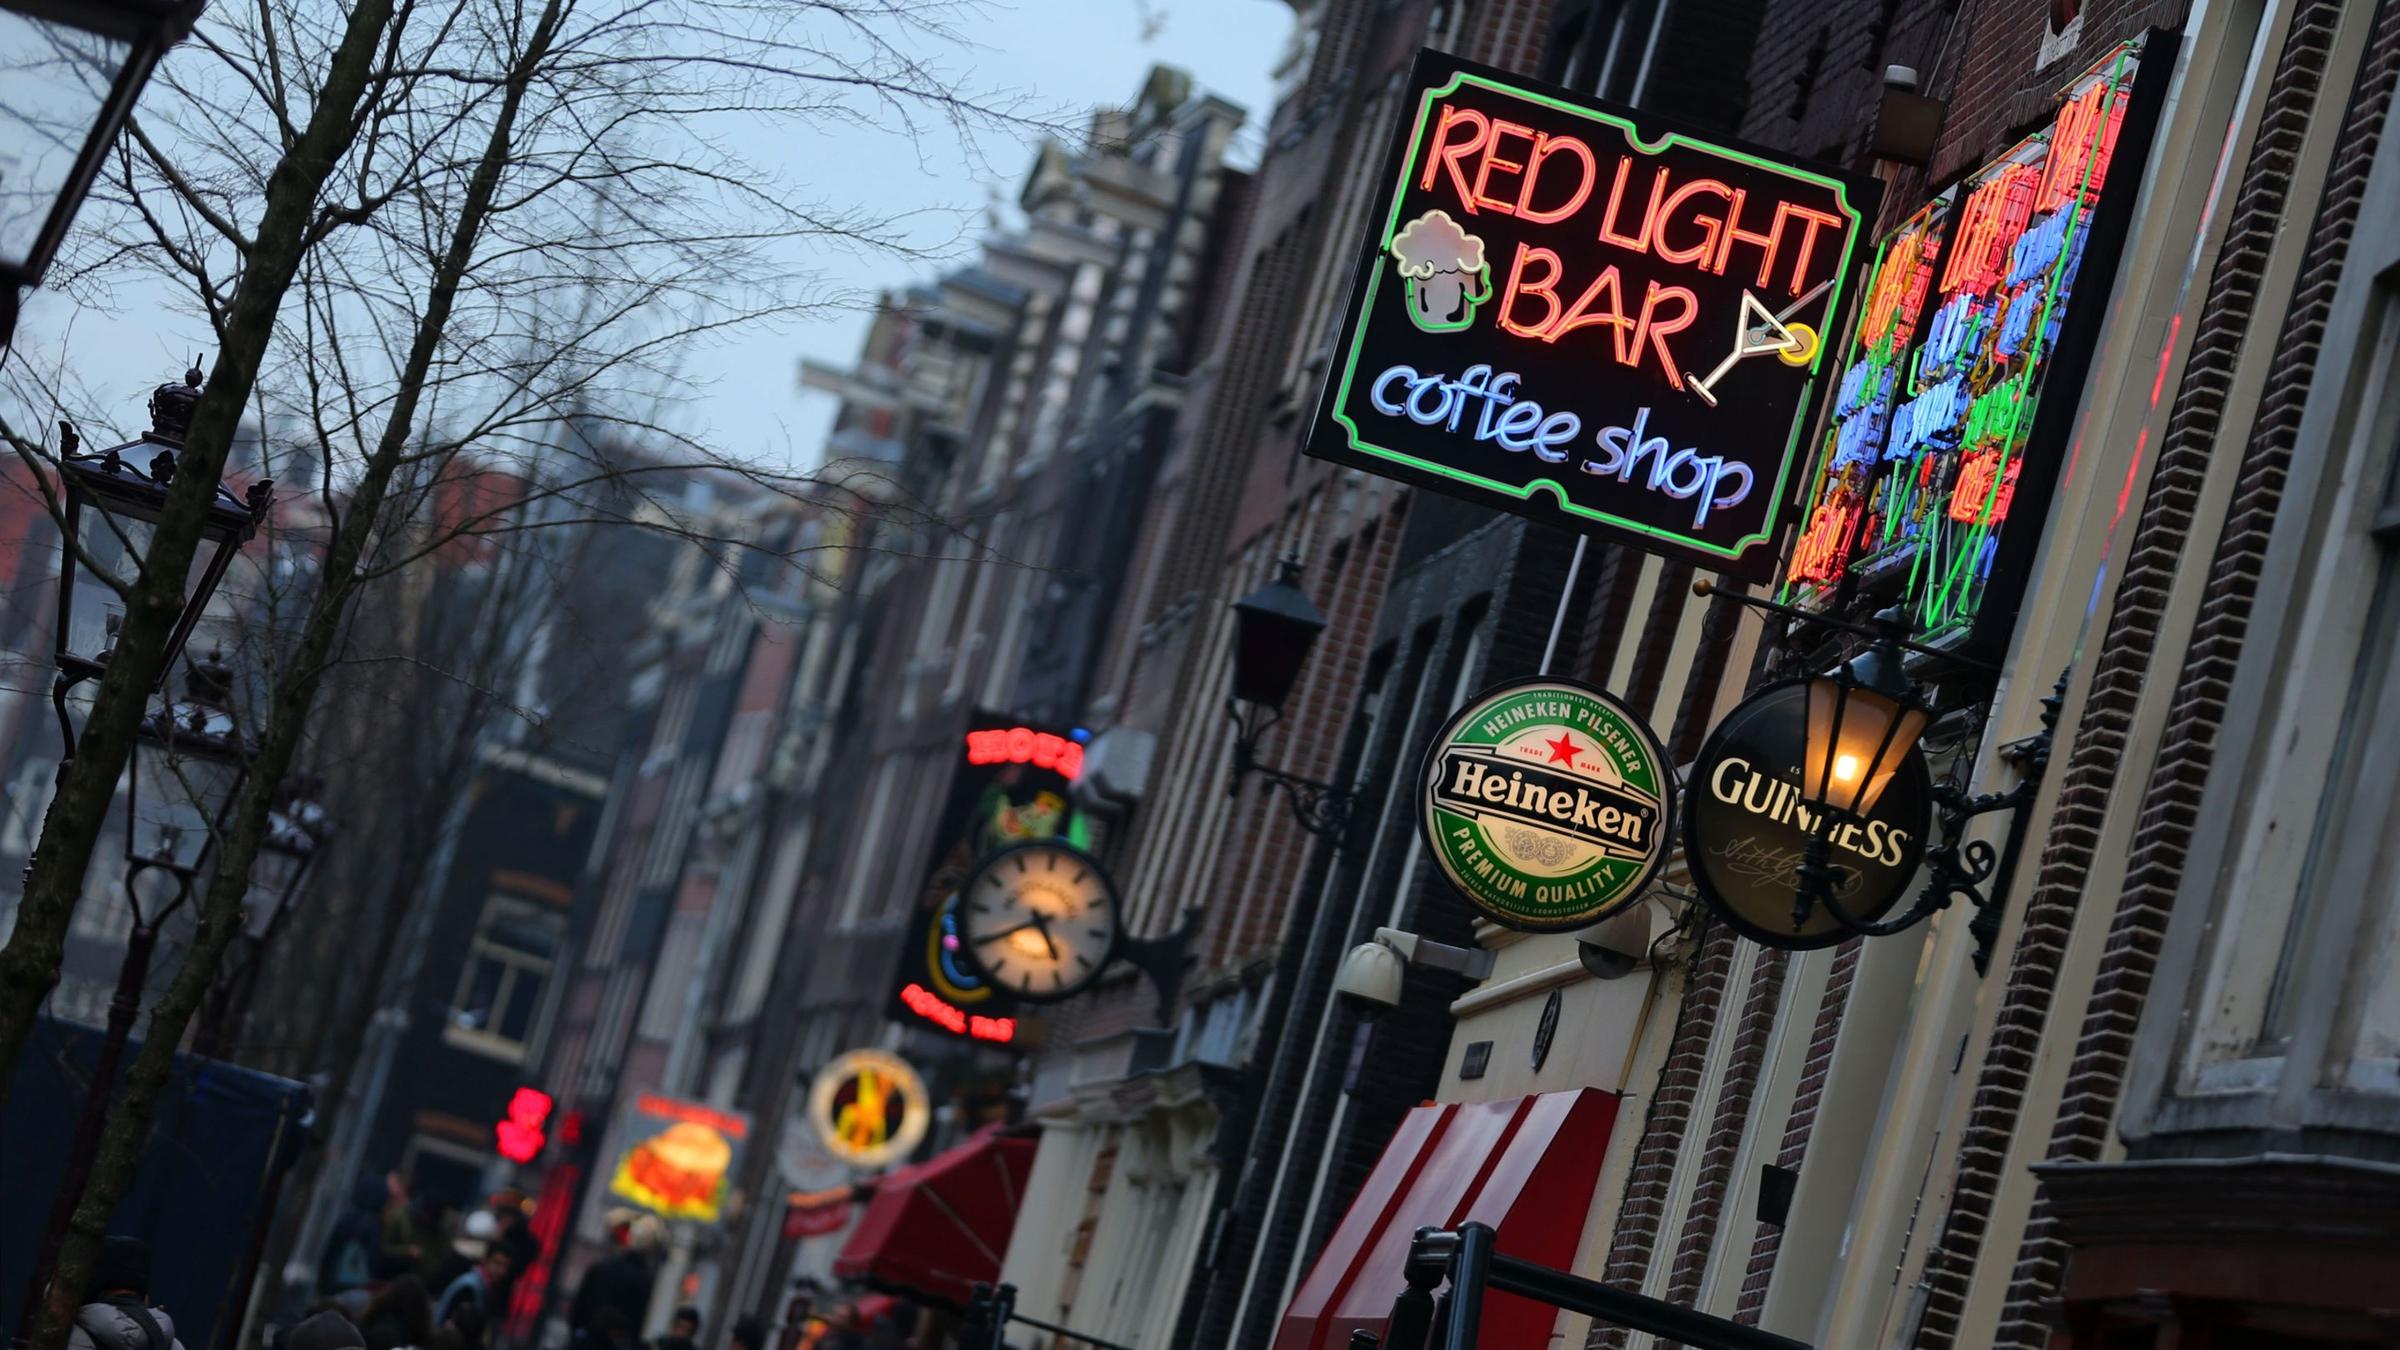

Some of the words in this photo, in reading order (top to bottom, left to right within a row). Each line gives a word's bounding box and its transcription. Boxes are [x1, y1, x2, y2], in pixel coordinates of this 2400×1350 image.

[1420, 103, 1597, 225] RED
[1599, 155, 1842, 296] LIGHT
[1497, 241, 1699, 391] BAR
[1371, 364, 1582, 462] coffee
[1581, 406, 1754, 529] shop
[1483, 701, 1571, 738] HEINEKEN
[1576, 709, 1642, 774] PILSENER
[1519, 745, 1544, 757] TRADE
[1580, 761, 1601, 773] MARK
[1451, 760, 1643, 842] Heineken
[1452, 827, 1528, 900] PREMIUM
[1535, 864, 1616, 903] QUALITY
